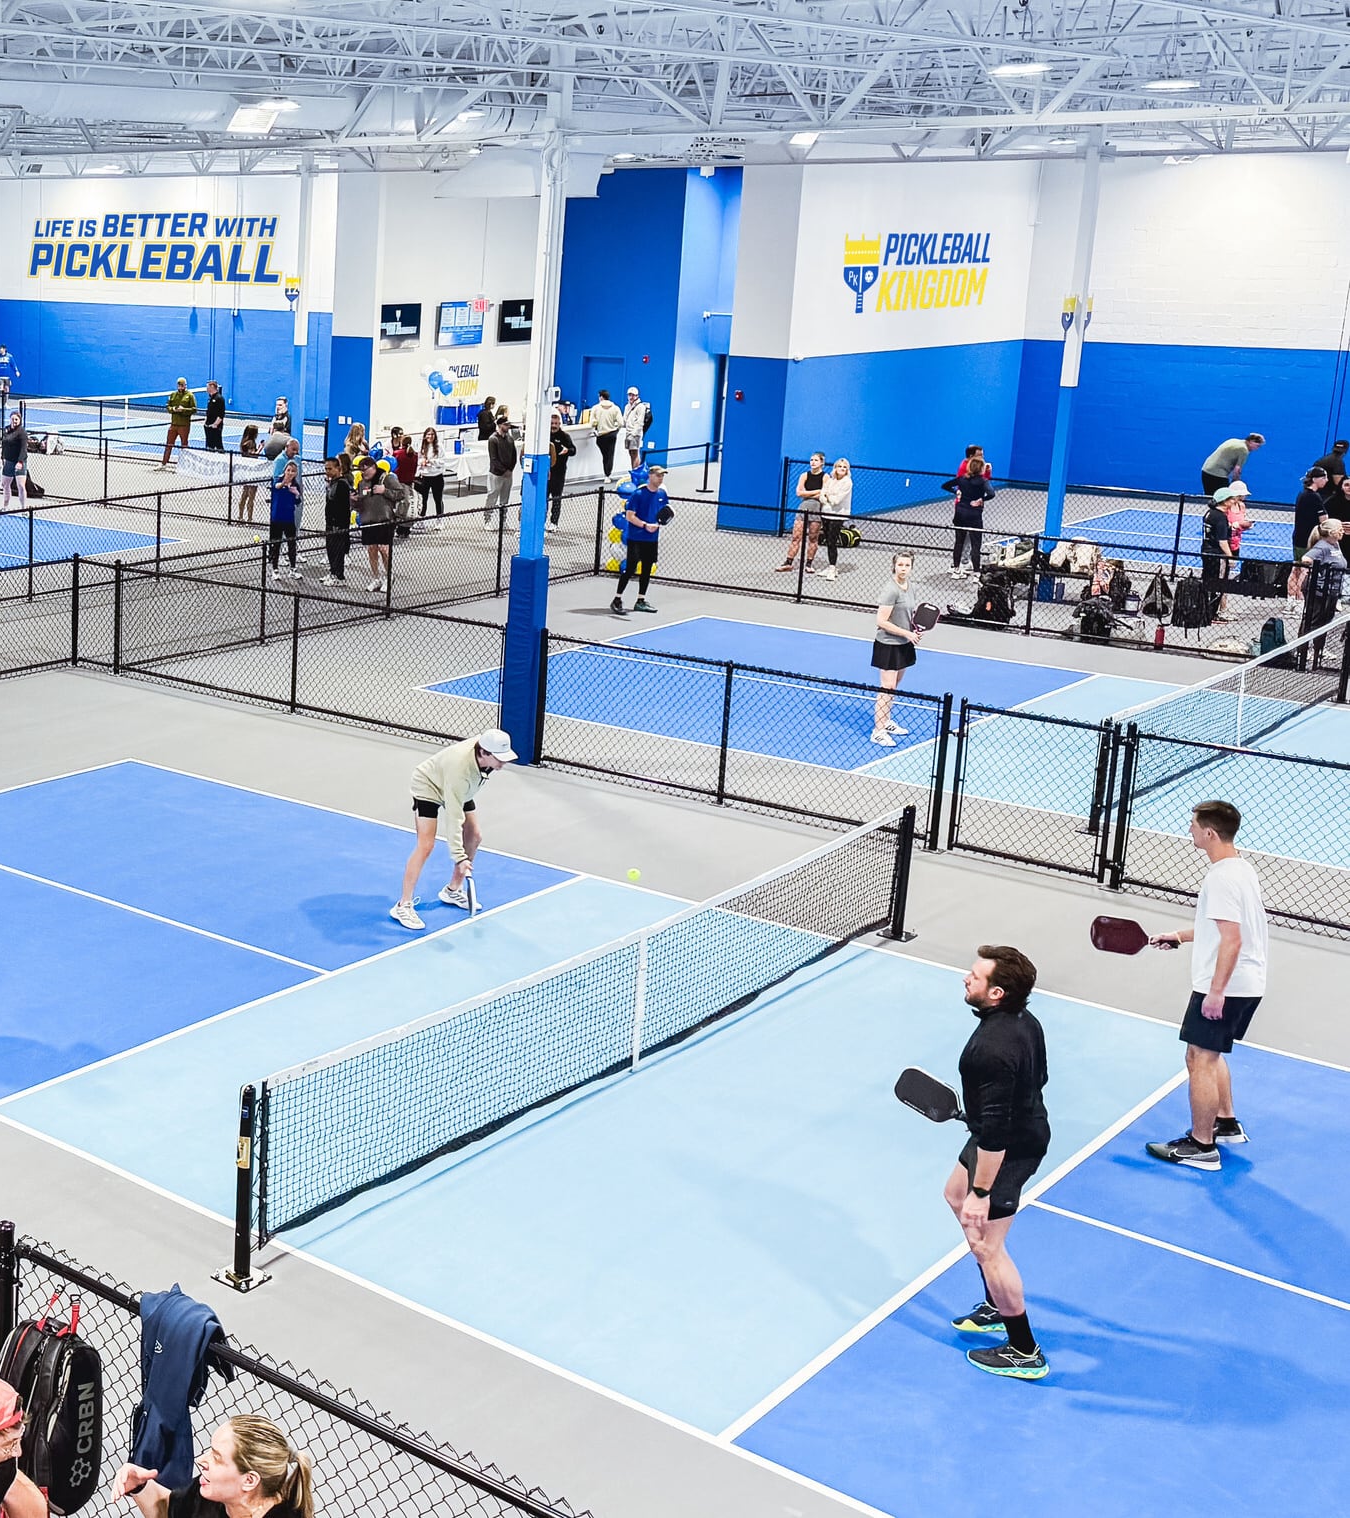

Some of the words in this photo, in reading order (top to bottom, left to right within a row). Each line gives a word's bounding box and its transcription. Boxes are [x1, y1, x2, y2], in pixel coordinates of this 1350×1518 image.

[34, 219, 74, 238] LIFE
[78, 219, 97, 238] IS
[101, 212, 209, 238] BETTER
[214, 217, 278, 238] WITH
[29, 242, 280, 284] PICKLEBALL
[882, 232, 991, 266] PICKLEBALL
[875, 267, 989, 312] KINGDOM
[76, 1381, 95, 1454] CRBN
